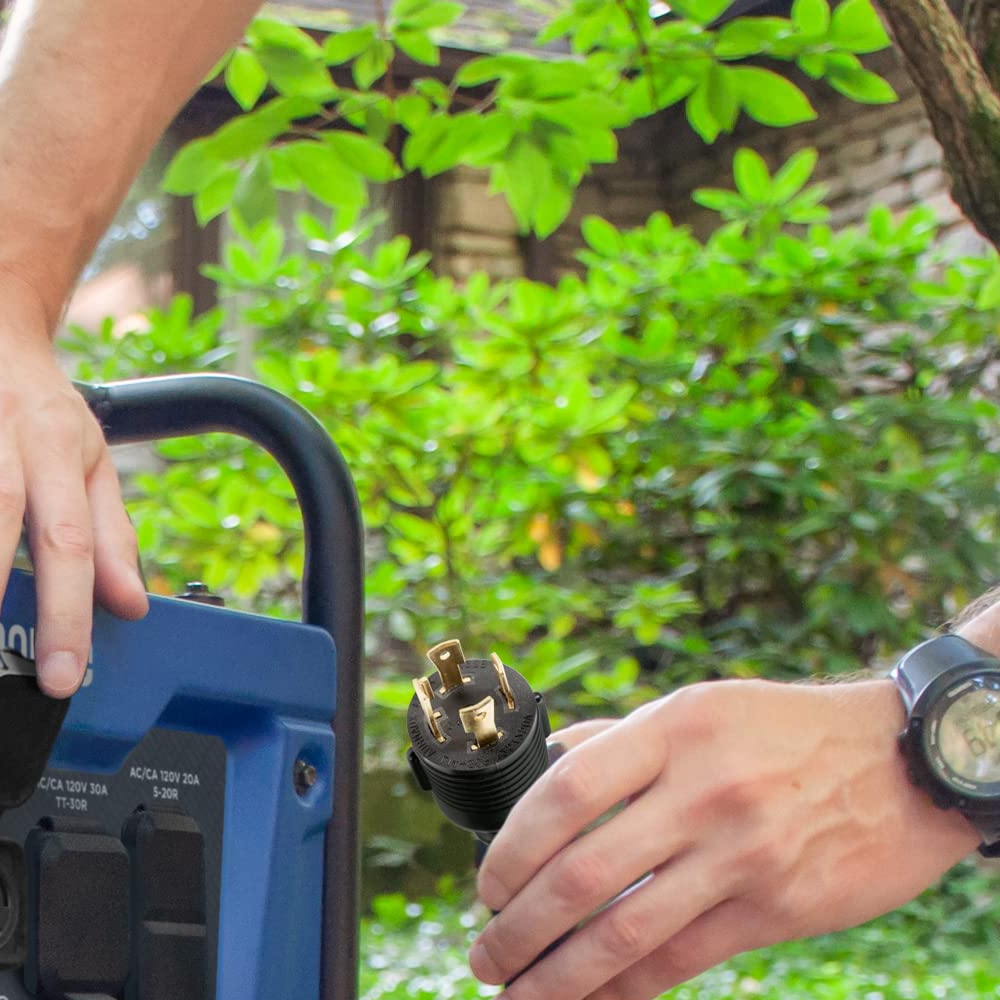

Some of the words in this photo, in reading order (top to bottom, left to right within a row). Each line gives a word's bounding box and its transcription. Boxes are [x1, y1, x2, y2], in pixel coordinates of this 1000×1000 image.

[130, 767, 158, 780] AC/CA
[160, 770, 180, 783] 120V
[182, 773, 200, 785] 20A
[37, 777, 64, 791] C/CA
[66, 780, 87, 793] 120V
[90, 783, 108, 796] 30A
[153, 786, 178, 800] 5-20R
[56, 796, 88, 811] TT-30R
